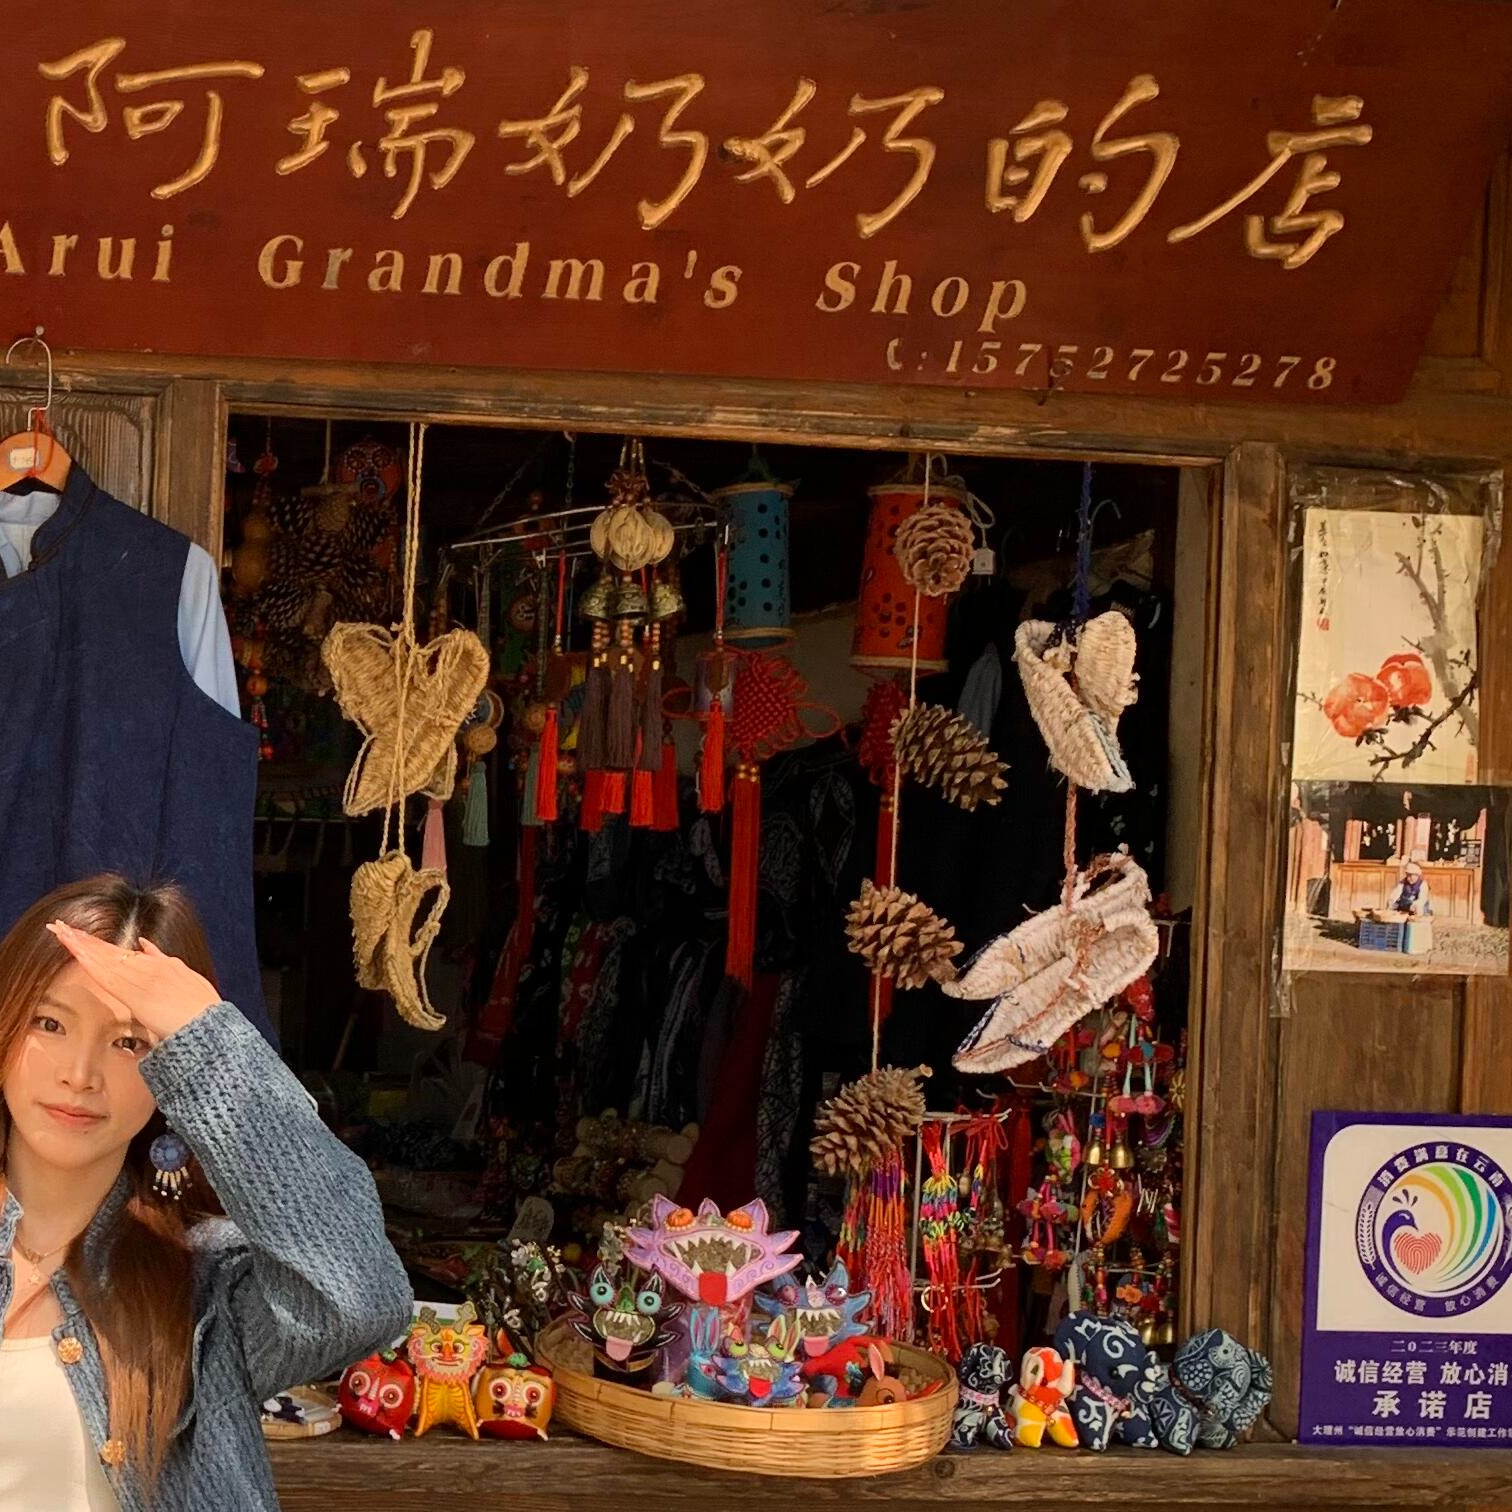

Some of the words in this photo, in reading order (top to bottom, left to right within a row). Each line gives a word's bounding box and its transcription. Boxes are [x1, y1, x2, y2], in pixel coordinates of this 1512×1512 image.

[38, 28, 1373, 269] 阿瑞奶奶的店
[257, 234, 741, 311] Grandma's
[815, 259, 1027, 333] Shop
[1334, 1359, 1427, 1385] 诚信经营
[1439, 1361, 1512, 1387] 放心消
[1372, 1390, 1493, 1420] 承诺店
